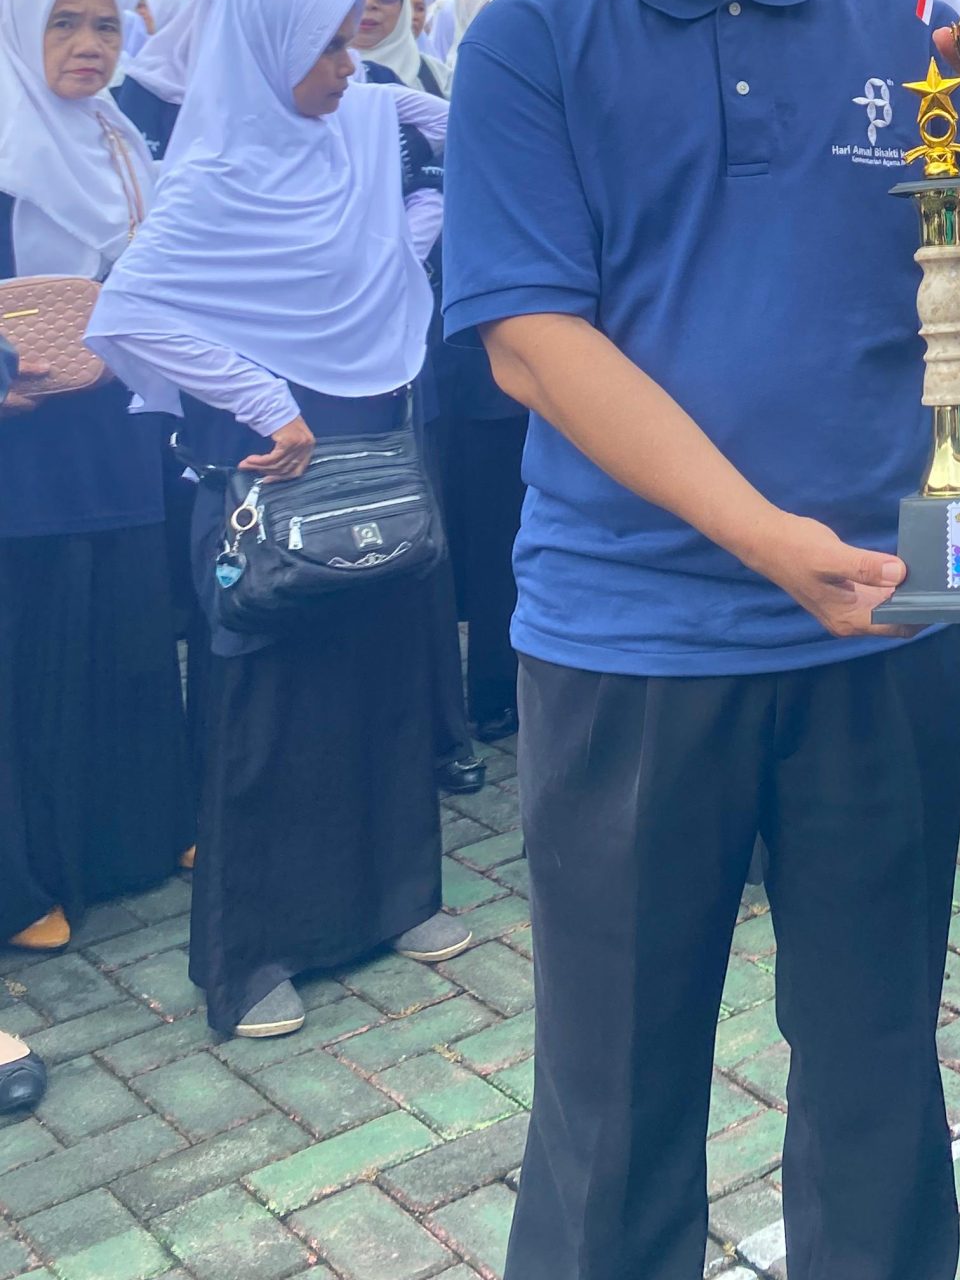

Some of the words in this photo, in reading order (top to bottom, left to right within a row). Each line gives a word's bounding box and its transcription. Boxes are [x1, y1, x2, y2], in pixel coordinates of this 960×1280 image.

[831, 145, 851, 155] Hari
[853, 146, 872, 157] Amal
[874, 147, 899, 158] Bhakti
